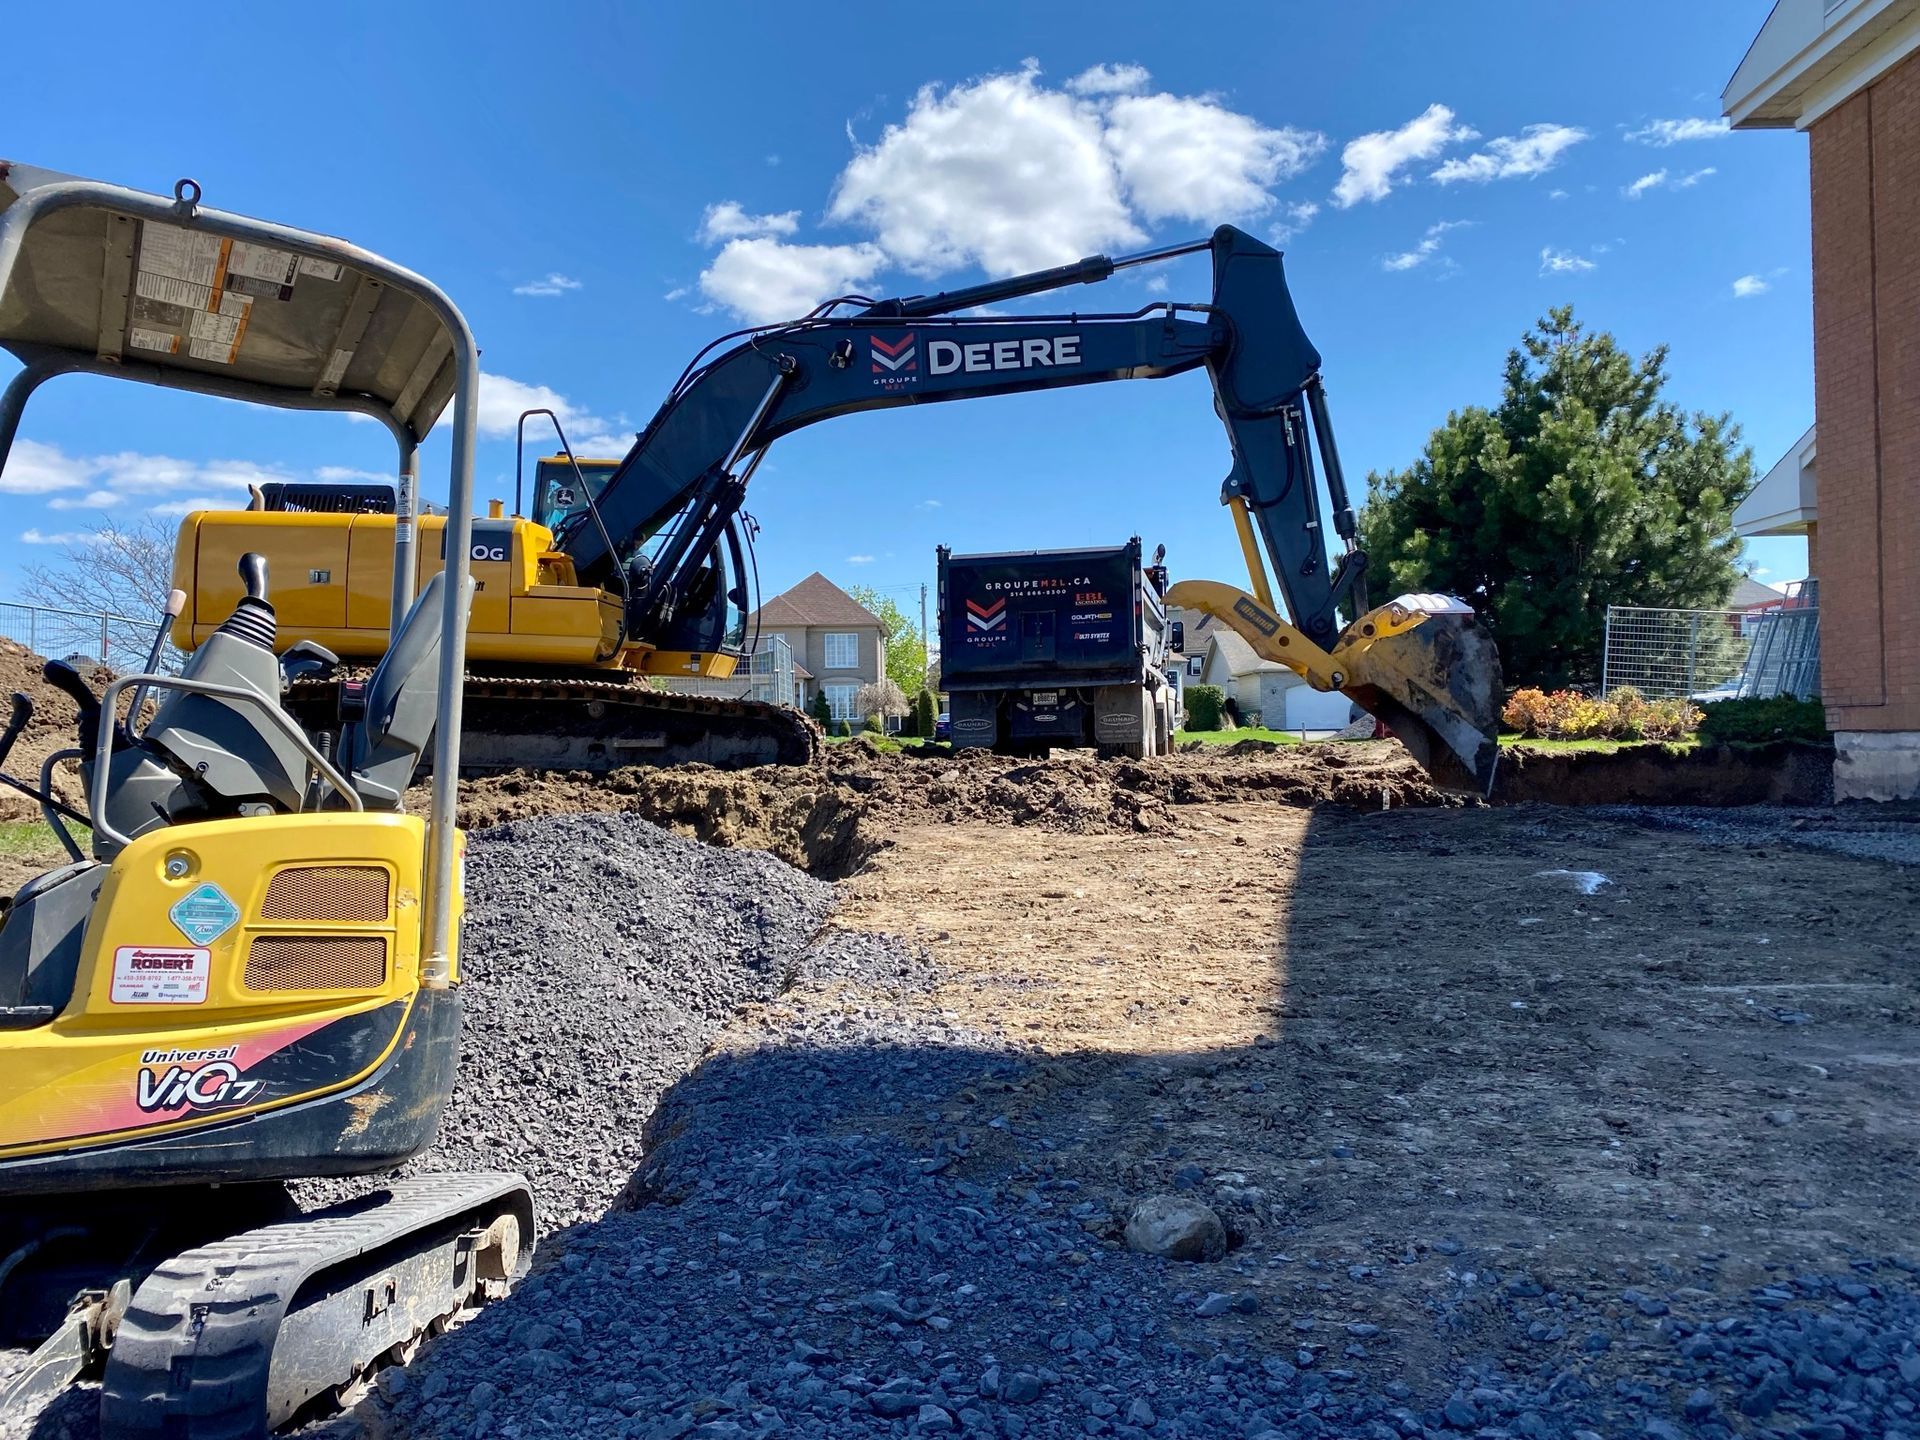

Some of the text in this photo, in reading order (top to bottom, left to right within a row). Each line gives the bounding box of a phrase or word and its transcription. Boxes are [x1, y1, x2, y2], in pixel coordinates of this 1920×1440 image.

[928, 335, 1081, 375] DEERE
[873, 376, 917, 385] GROUPE
[985, 577, 1091, 590] GROUPEM2L.CA
[966, 635, 1007, 643] GROUPE
[130, 958, 194, 970] ROBERT
[141, 1045, 239, 1064] Universal
